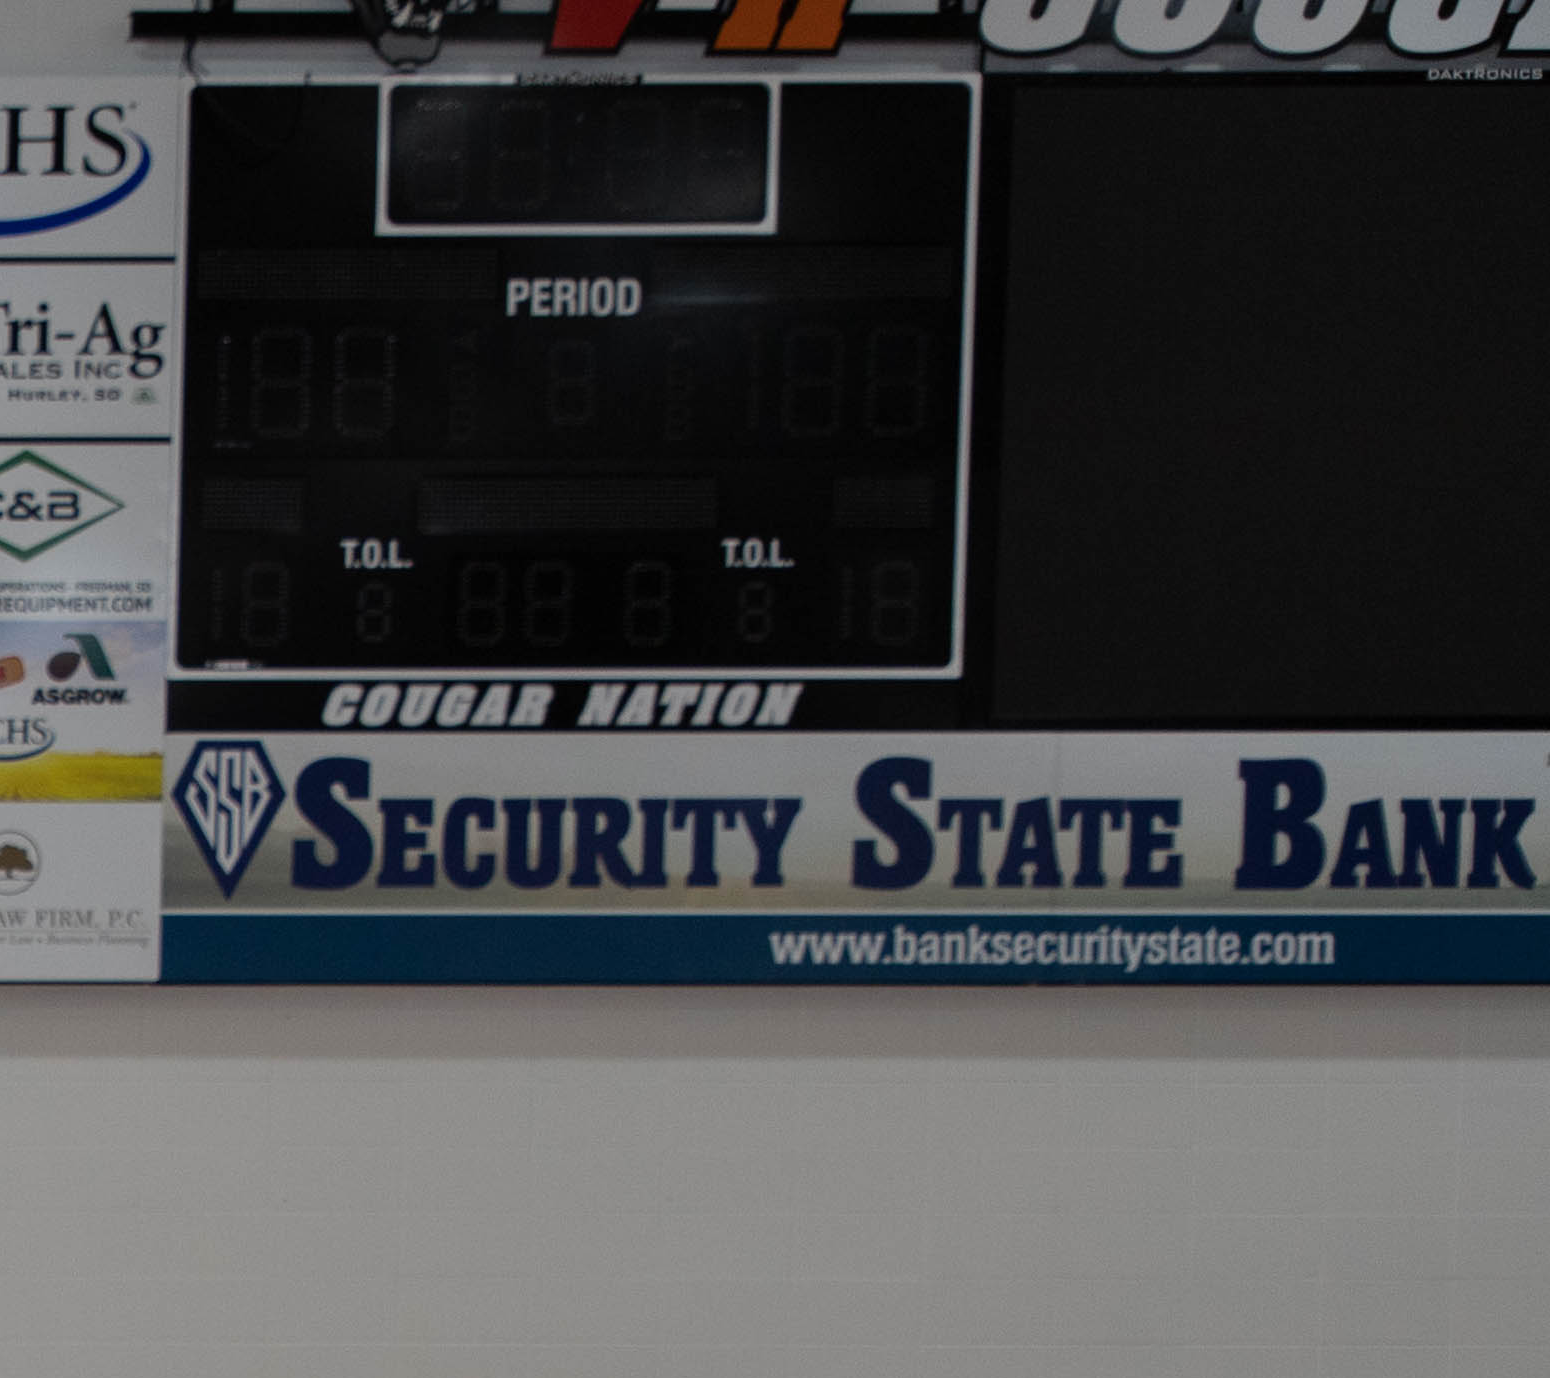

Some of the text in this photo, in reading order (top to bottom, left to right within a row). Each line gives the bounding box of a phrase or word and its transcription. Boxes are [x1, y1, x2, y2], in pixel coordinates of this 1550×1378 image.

[1427, 66, 1543, 81] DAKTRONICS
[506, 279, 642, 317] PERIOD
[74, 359, 123, 380] INC
[341, 538, 413, 569] T.O.L.
[722, 537, 795, 568] T.O.L.
[32, 688, 126, 705] ASGROW
[321, 683, 804, 727] COUGAR NATION
[291, 756, 1538, 892] SECURITY STATE BANK
[769, 925, 1336, 973] www.banksecuritystate.com
